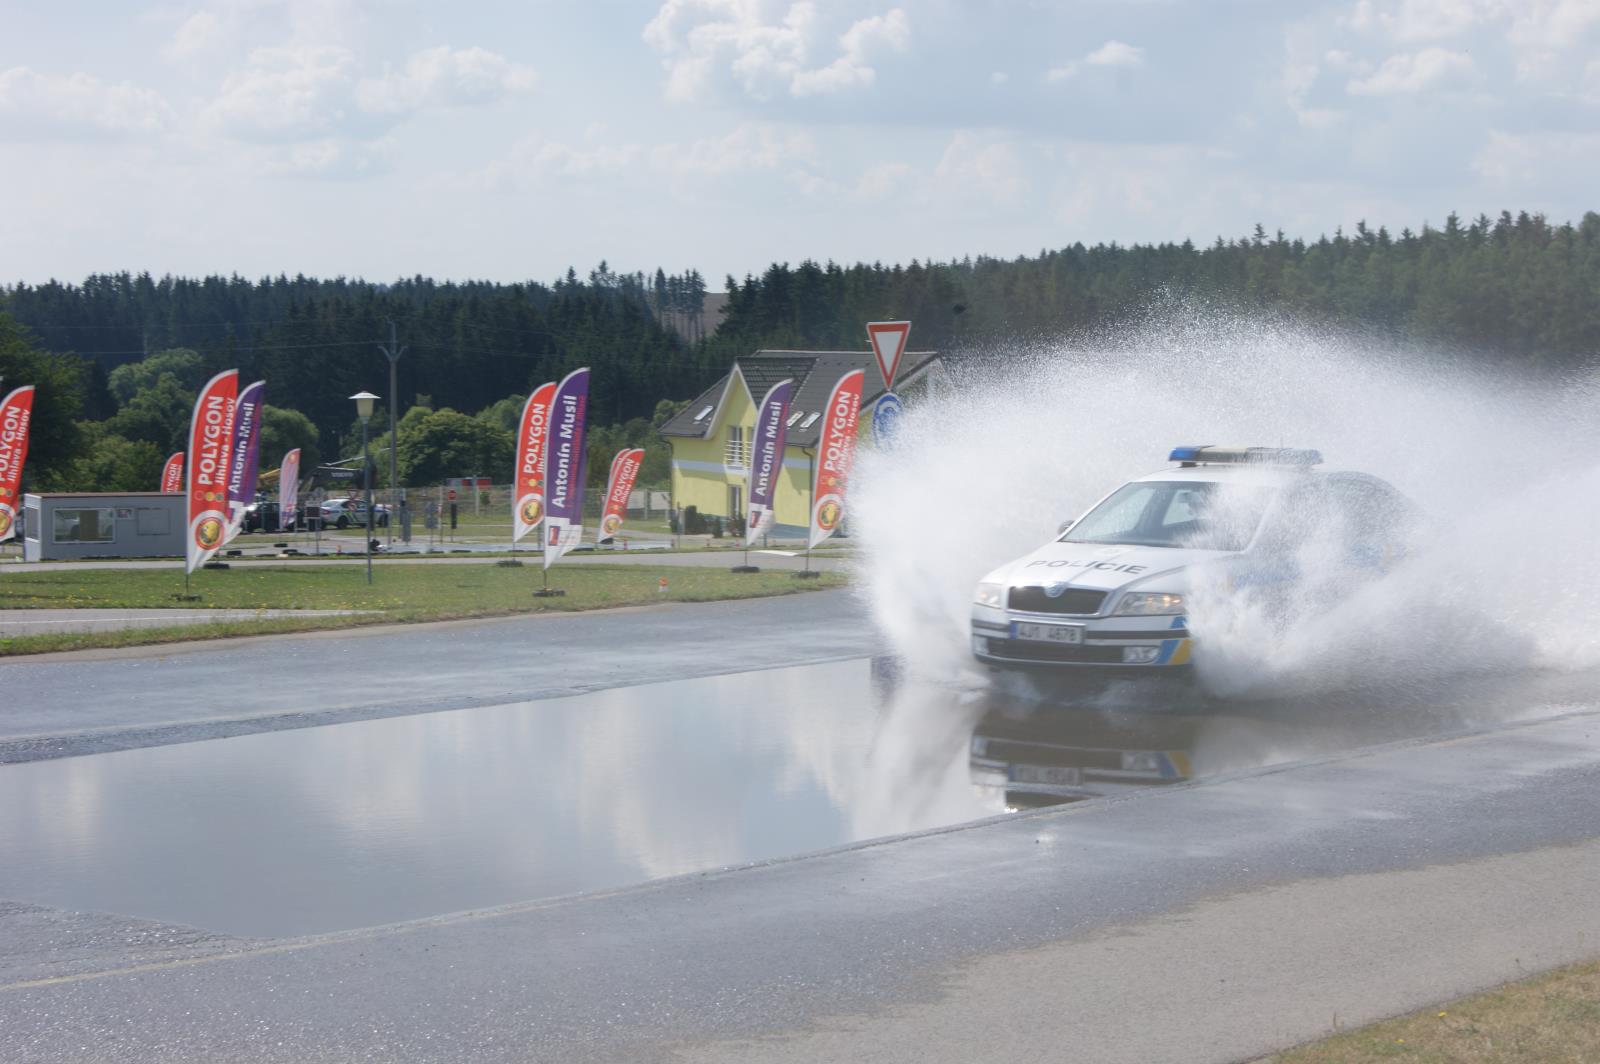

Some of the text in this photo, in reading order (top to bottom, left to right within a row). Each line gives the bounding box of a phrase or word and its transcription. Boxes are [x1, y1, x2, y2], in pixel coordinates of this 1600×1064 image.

[7, 448, 21, 482] Jihlava
[16, 409, 30, 440] Hosov
[198, 396, 224, 485] POLYGON
[222, 397, 235, 434] Hosov
[228, 402, 255, 494] Antonín Musil
[523, 403, 545, 474] POLYGON
[560, 395, 577, 439] Musil
[755, 401, 782, 496] Antonín Musil
[824, 391, 851, 471] POLYGON
[215, 443, 230, 486] Jihlava
[552, 443, 571, 508] Antonín
[612, 458, 635, 502] POLYGON
[1025, 560, 1149, 575] POLICIE
